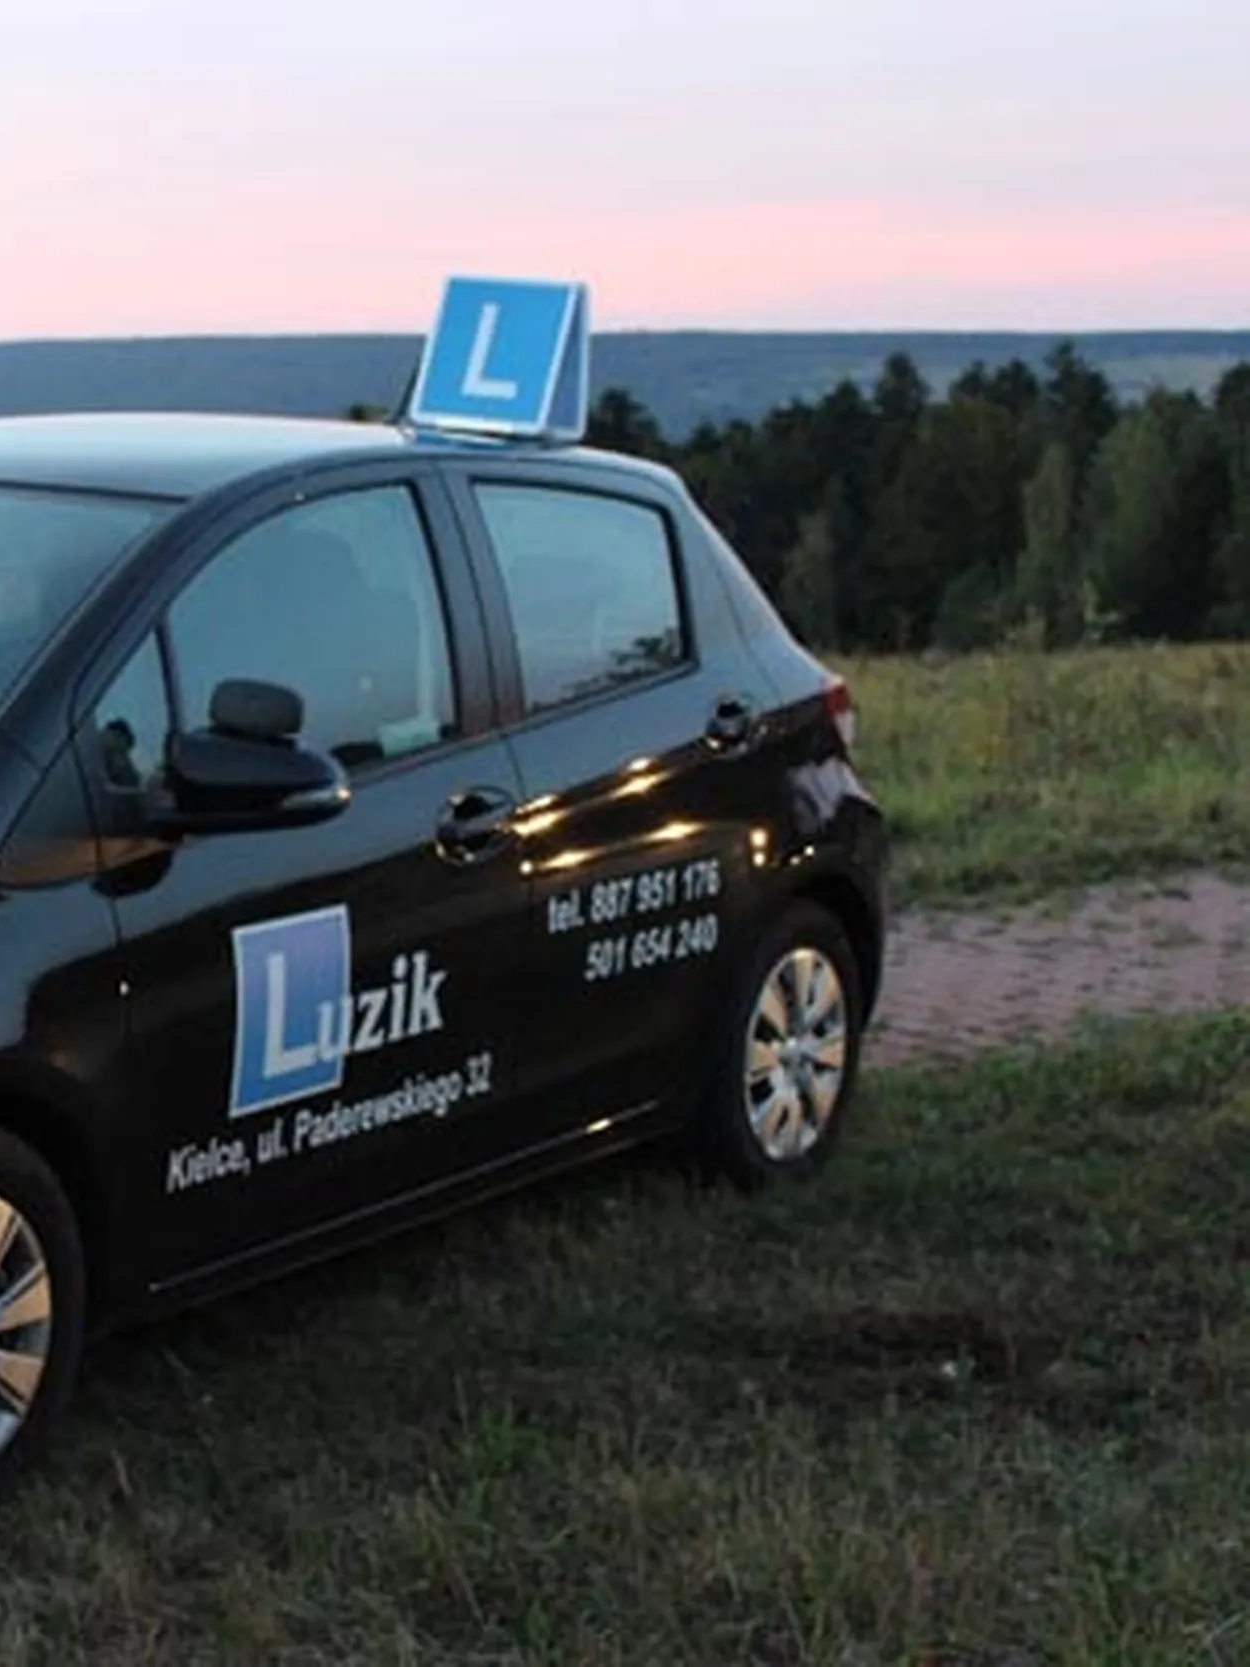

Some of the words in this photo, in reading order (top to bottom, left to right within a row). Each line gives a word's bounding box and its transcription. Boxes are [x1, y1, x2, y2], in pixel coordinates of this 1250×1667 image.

[461, 302, 518, 399] L
[547, 888, 585, 934] tel.
[636, 868, 677, 913] 951
[583, 935, 627, 981] 501
[630, 925, 672, 968] 654
[262, 949, 448, 1080] Luzik
[256, 1117, 288, 1164] ul.
[292, 1069, 464, 1155] Paderewskiego
[465, 1050, 493, 1095] 32
